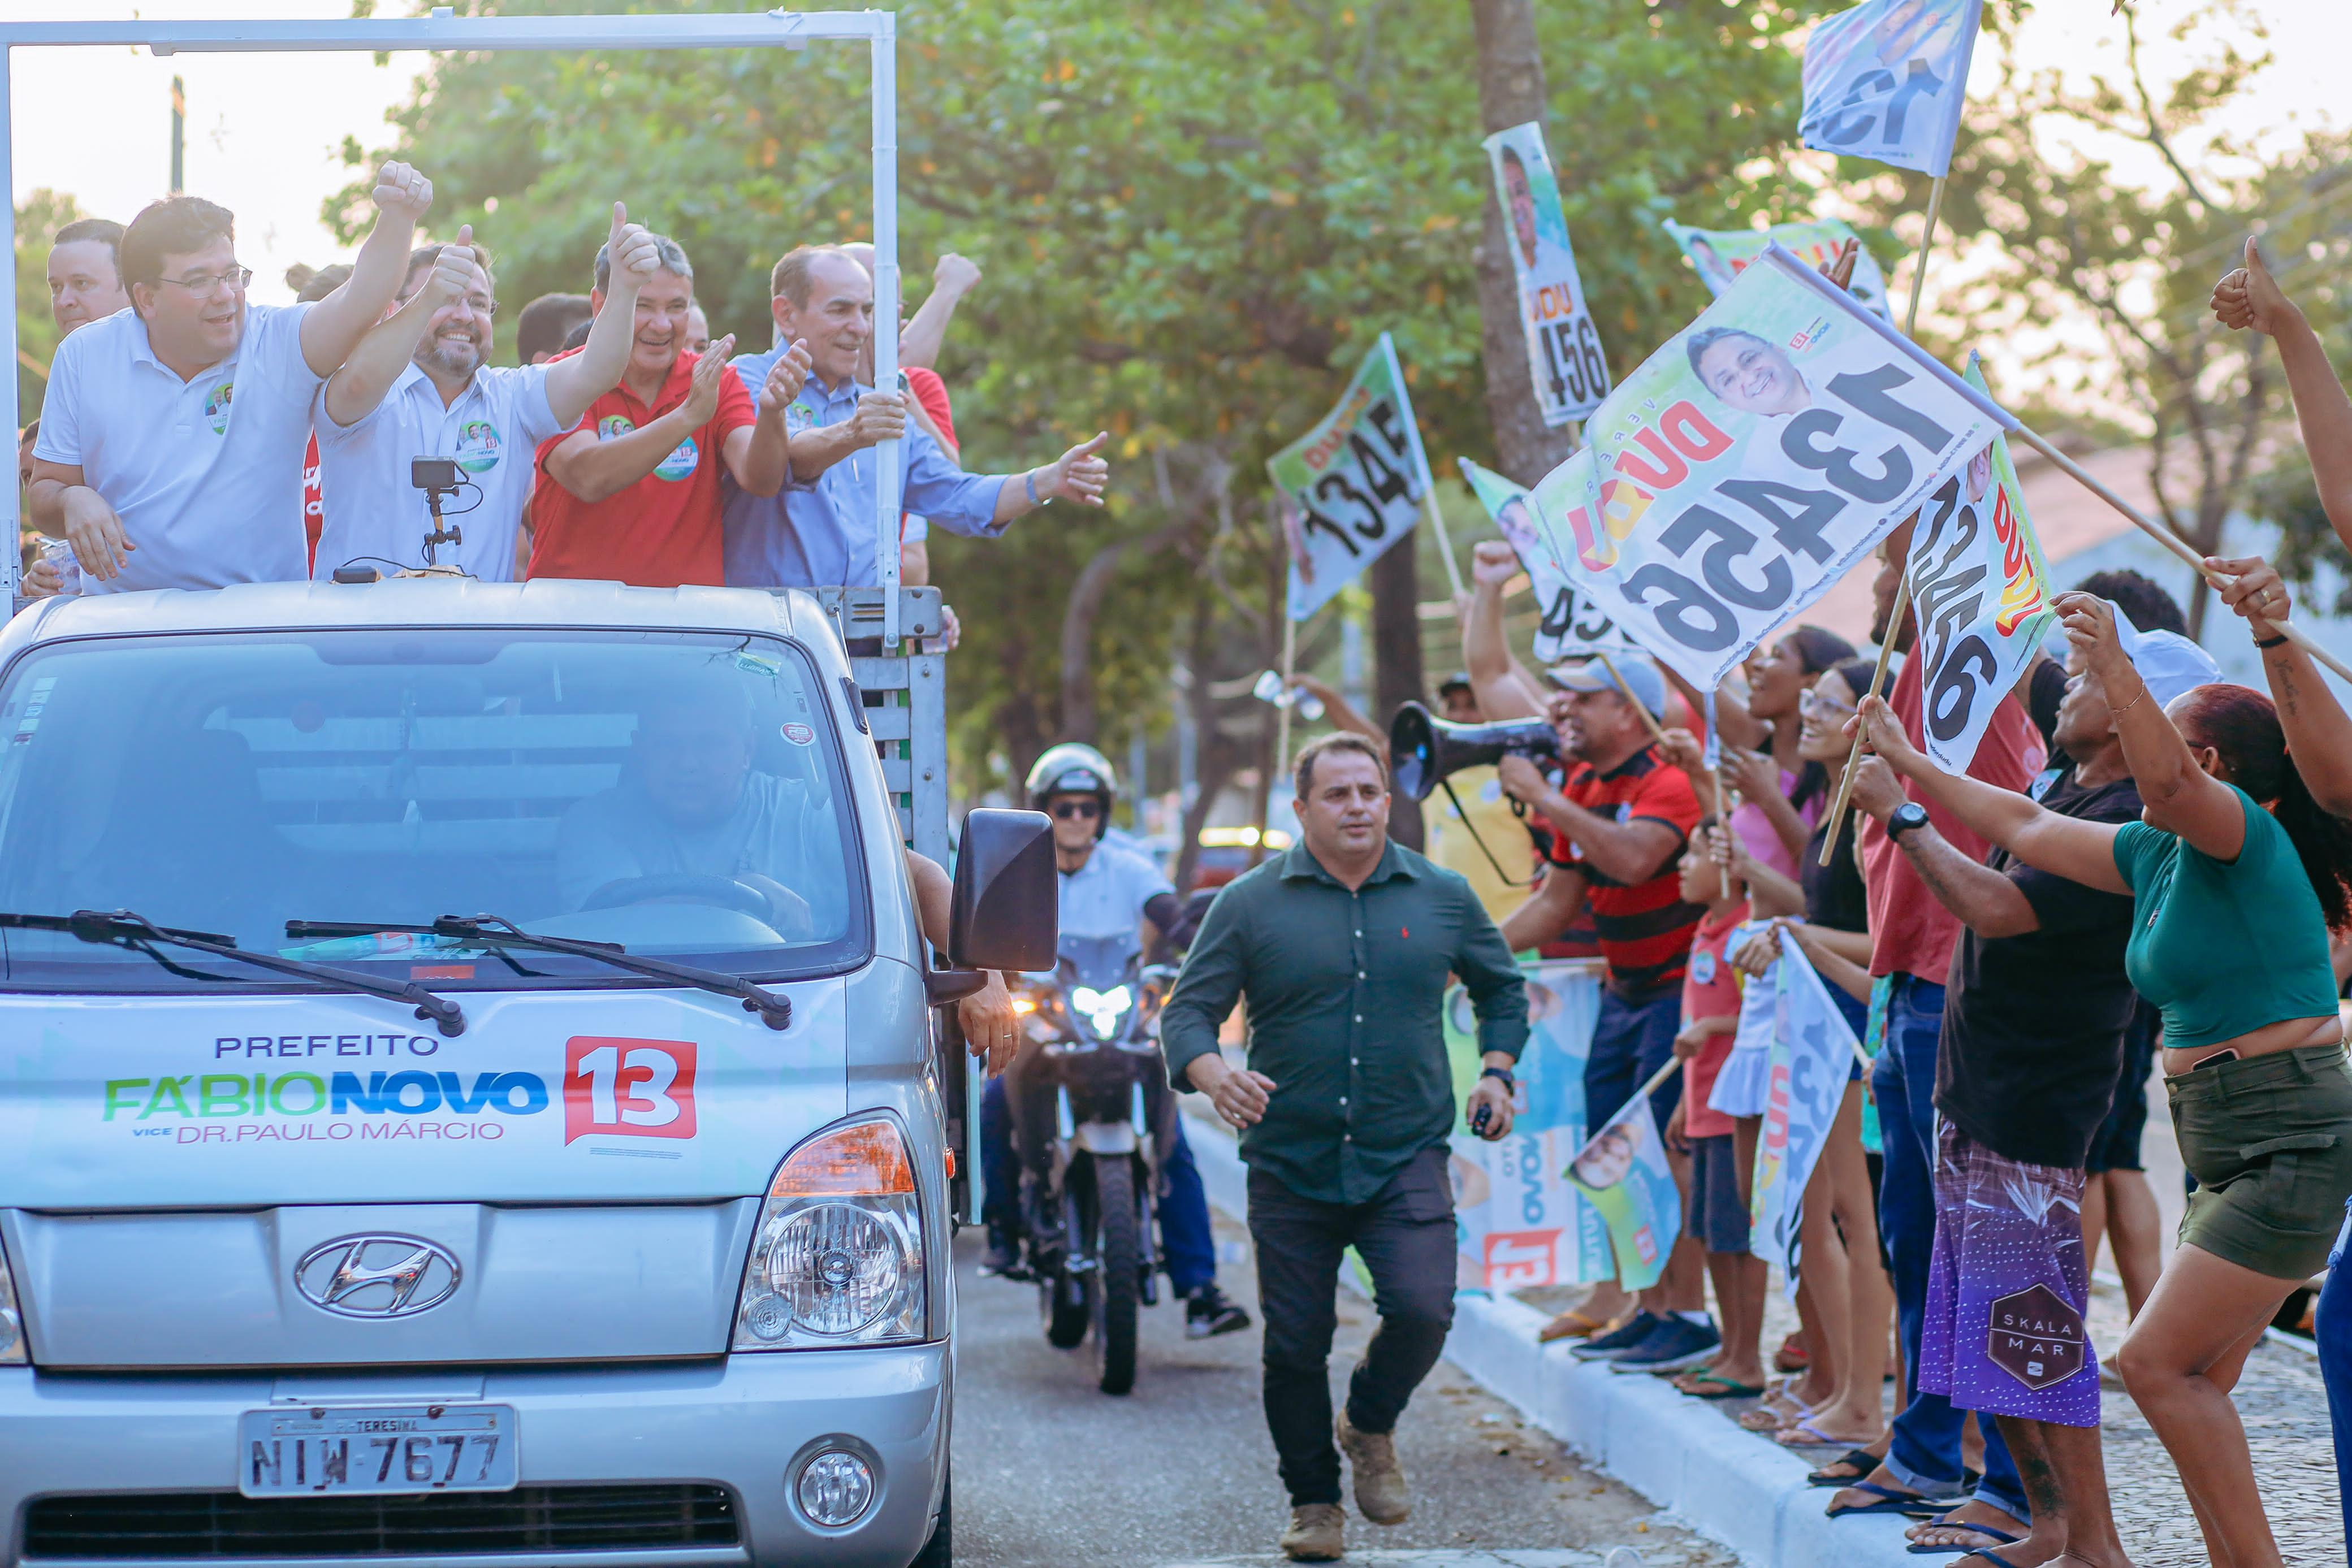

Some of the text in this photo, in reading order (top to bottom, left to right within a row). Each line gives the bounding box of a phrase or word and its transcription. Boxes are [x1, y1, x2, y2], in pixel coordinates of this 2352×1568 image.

[1993, 482, 2043, 637] DUDU
[1913, 475, 1997, 741] 13456
[215, 1034, 439, 1059] PREFEITO
[577, 1046, 681, 1127] 13
[132, 1127, 172, 1137] VICE
[361, 1119, 504, 1141] MÁRCIO
[2003, 1314, 2073, 1336] SKALA
[2008, 1336, 2065, 1357] MAR
